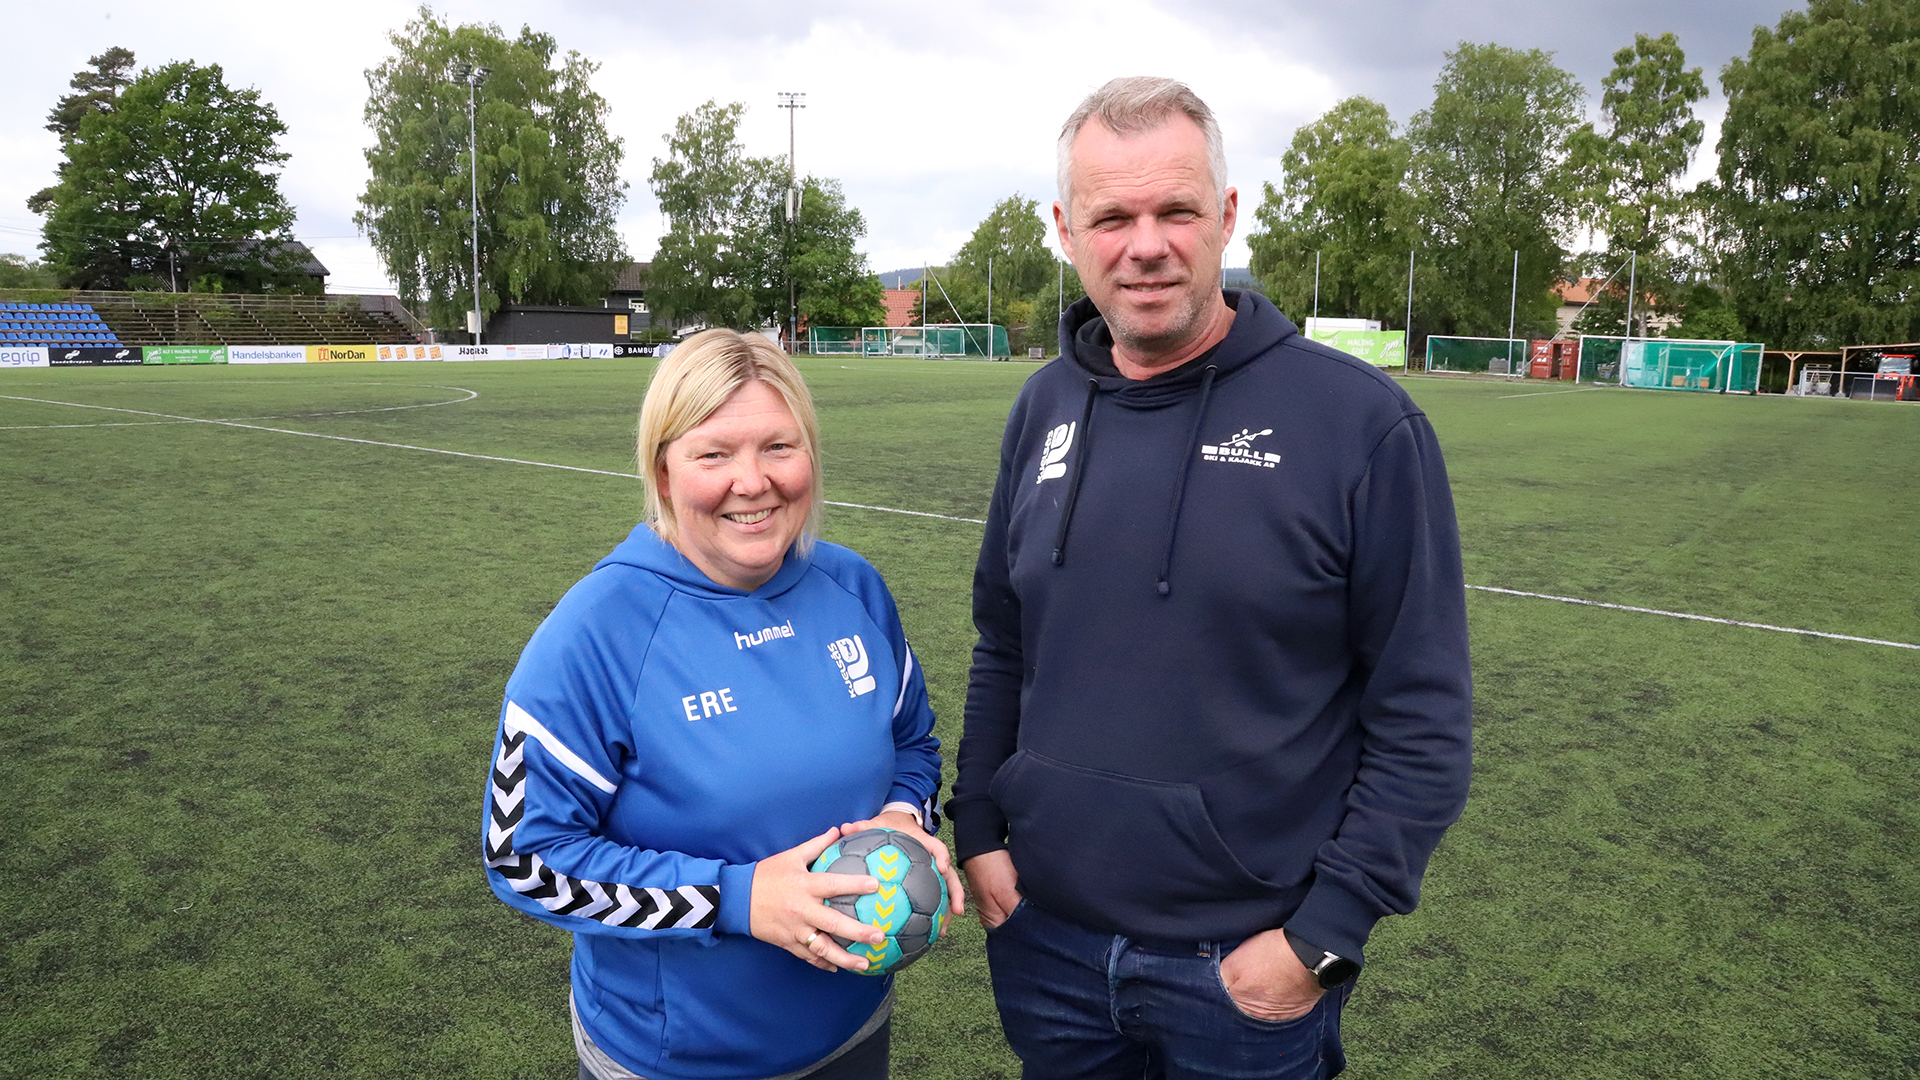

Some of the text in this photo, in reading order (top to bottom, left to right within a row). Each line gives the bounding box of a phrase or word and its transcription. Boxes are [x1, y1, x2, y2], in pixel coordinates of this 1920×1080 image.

[1347, 339, 1375, 347] MALING
[232, 350, 302, 360] Handelsbanken
[330, 350, 365, 360] NorDan
[1351, 347, 1370, 355] GULV
[1218, 446, 1264, 461] BULL
[1228, 457, 1262, 467] KAJAKK
[733, 620, 795, 650] hummel
[682, 687, 738, 722] ERE
